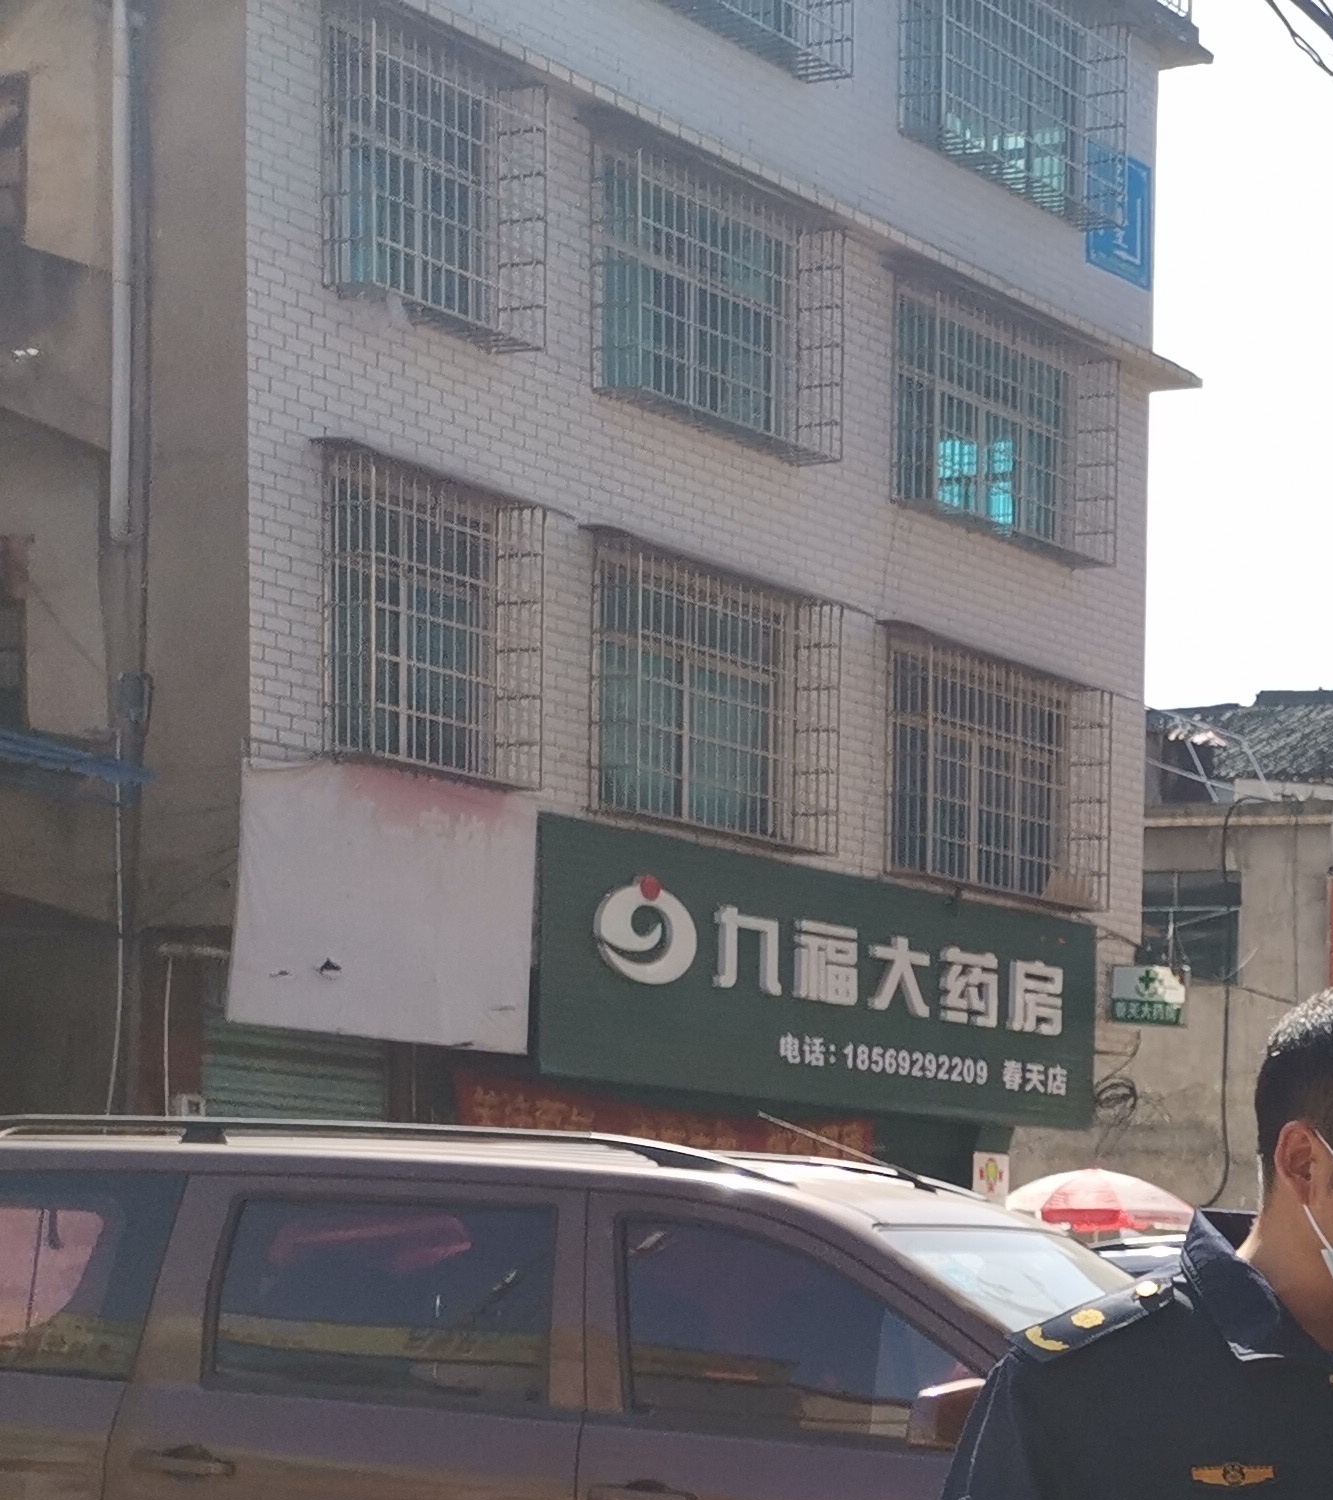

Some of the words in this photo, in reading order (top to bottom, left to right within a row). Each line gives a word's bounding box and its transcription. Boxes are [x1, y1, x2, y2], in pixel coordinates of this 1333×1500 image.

[712, 903, 1065, 1037] 九福大药房
[1002, 1059, 1068, 1097] 春天店
